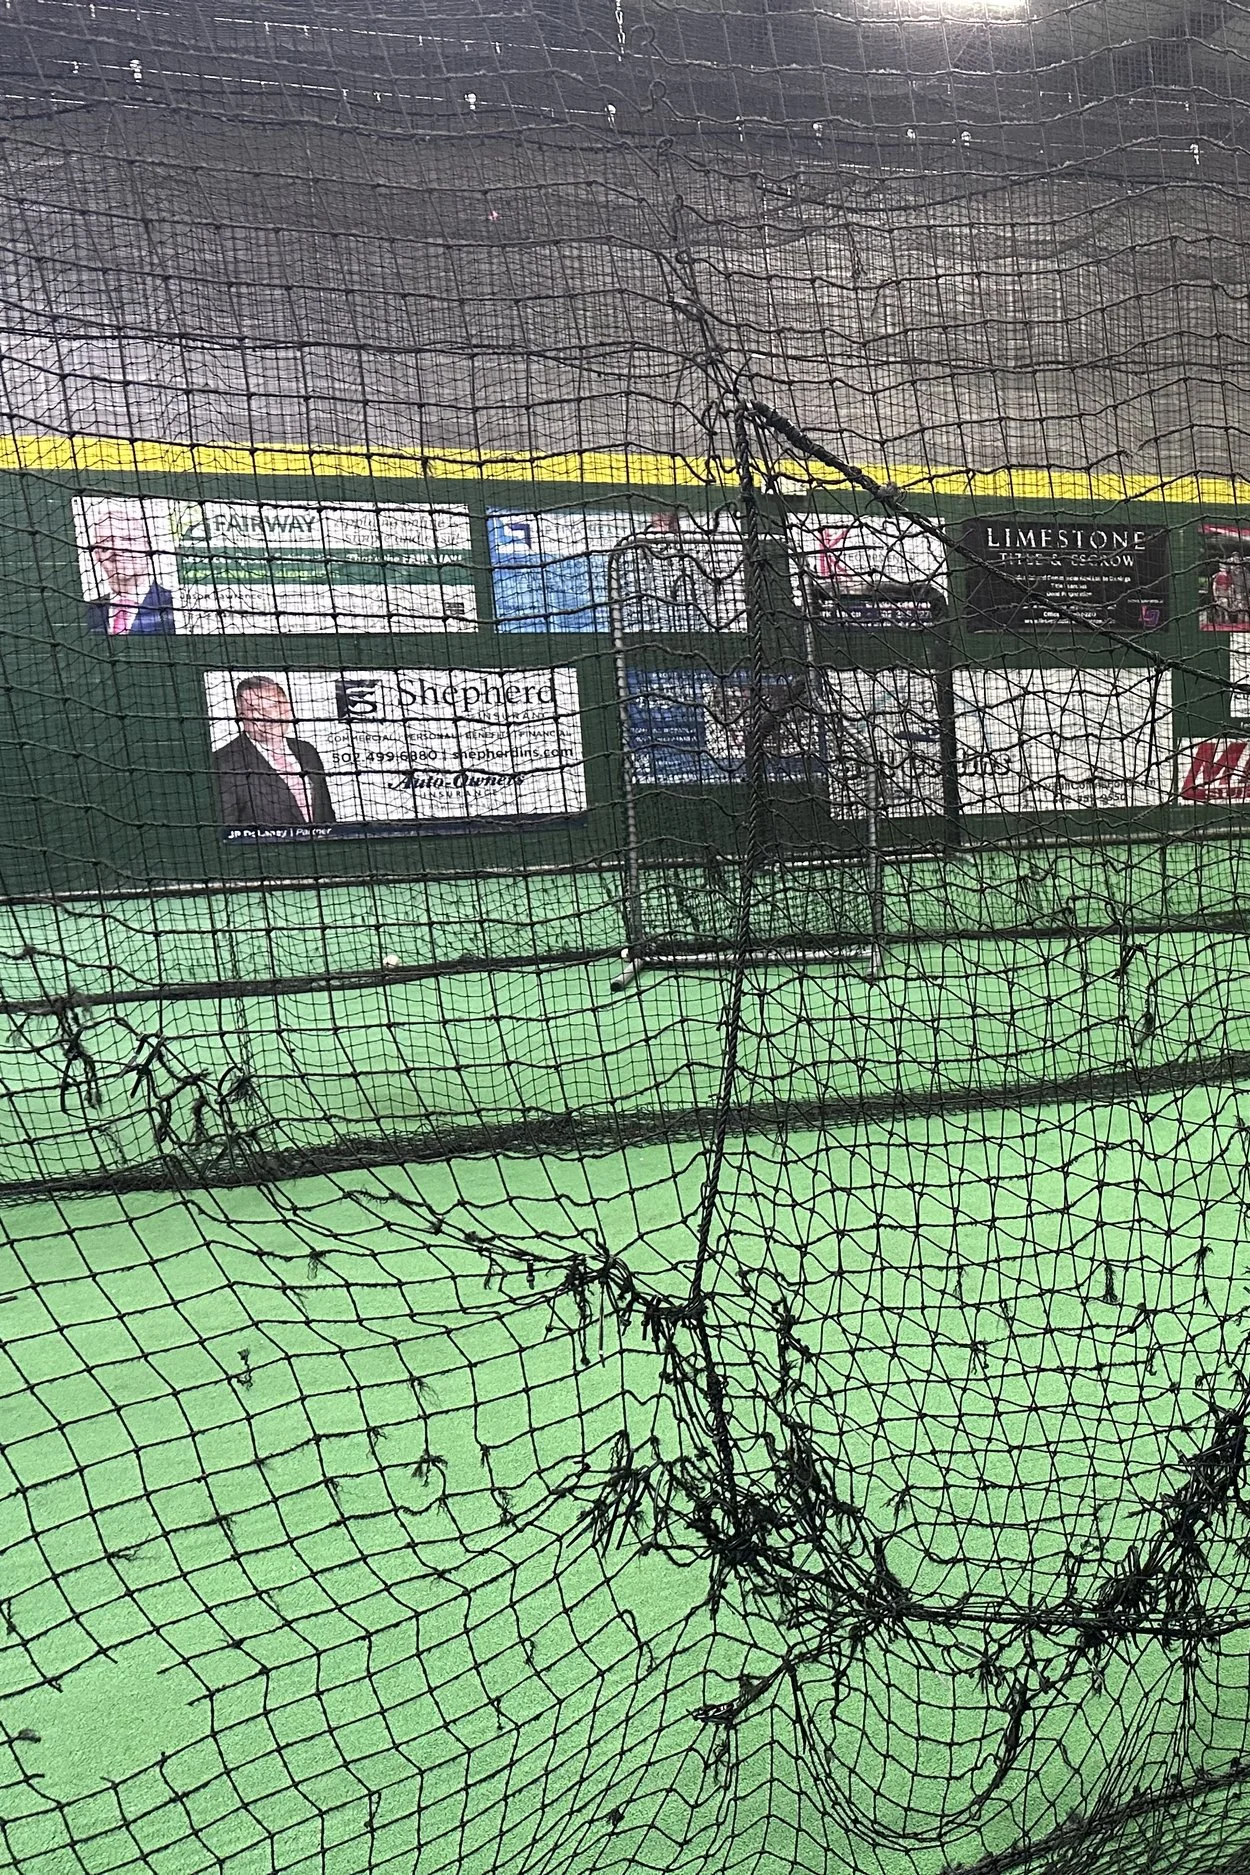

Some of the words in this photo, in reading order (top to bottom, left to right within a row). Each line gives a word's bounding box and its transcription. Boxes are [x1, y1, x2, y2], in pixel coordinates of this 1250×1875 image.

[214, 514, 316, 533] FAIRWAY
[987, 527, 1146, 550] LIMESTONE
[1052, 552, 1062, 566] &
[398, 677, 555, 712] Shepherd
[388, 772, 526, 790] Auto-Owners
